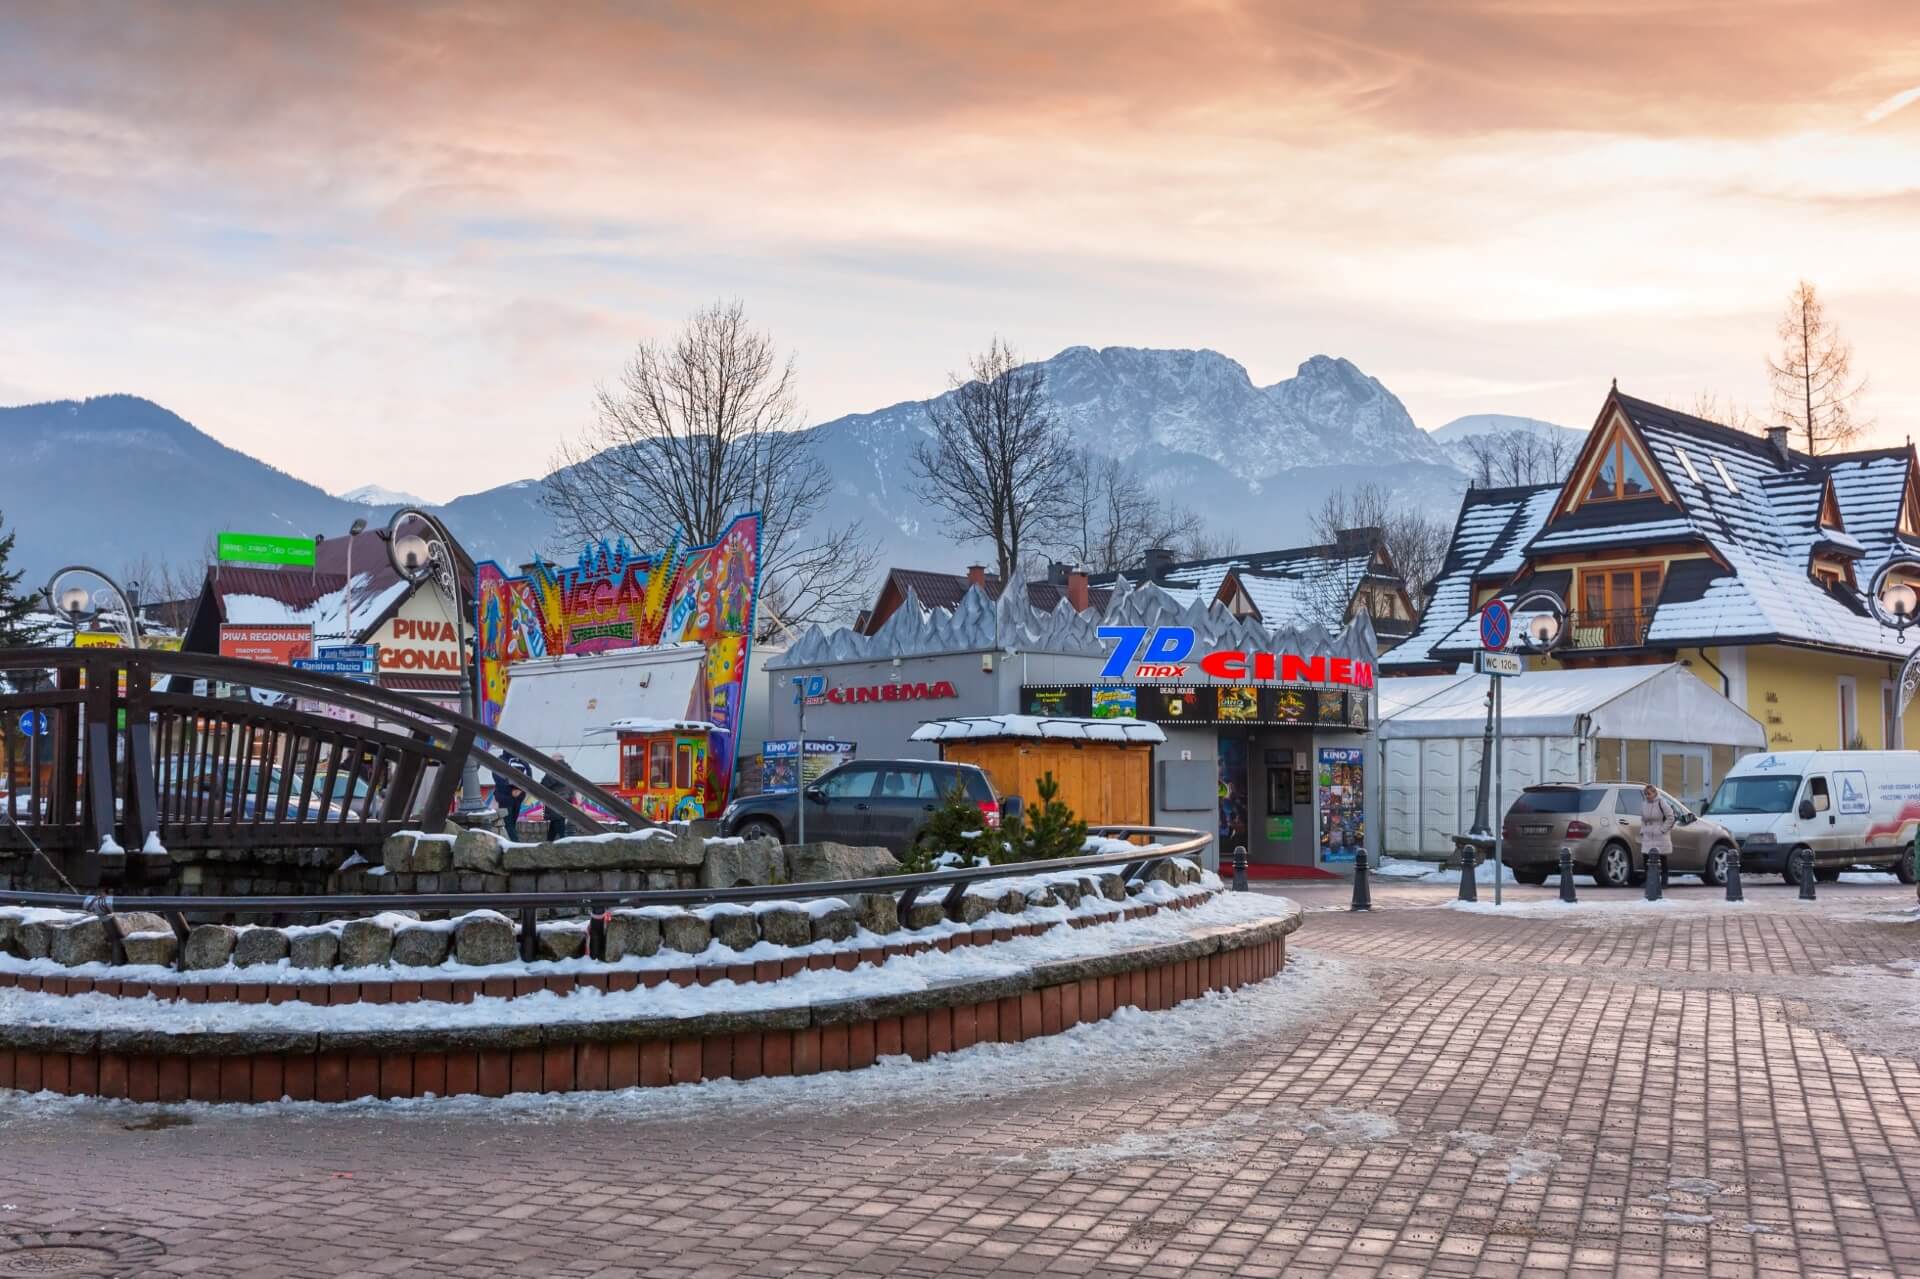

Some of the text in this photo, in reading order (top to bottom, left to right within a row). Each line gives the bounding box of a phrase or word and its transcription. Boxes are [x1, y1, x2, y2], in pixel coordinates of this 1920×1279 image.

[393, 618, 457, 642] PIWA
[222, 632, 311, 641] PIWA REGIONALNE
[1096, 625, 1374, 689] 7D CINEM
[1485, 657, 1497, 669] WC
[792, 675, 958, 704] 7D CINEMA
[766, 742, 787, 752] KINO
[804, 742, 835, 751] KINO
[1323, 751, 1347, 760] KINO
